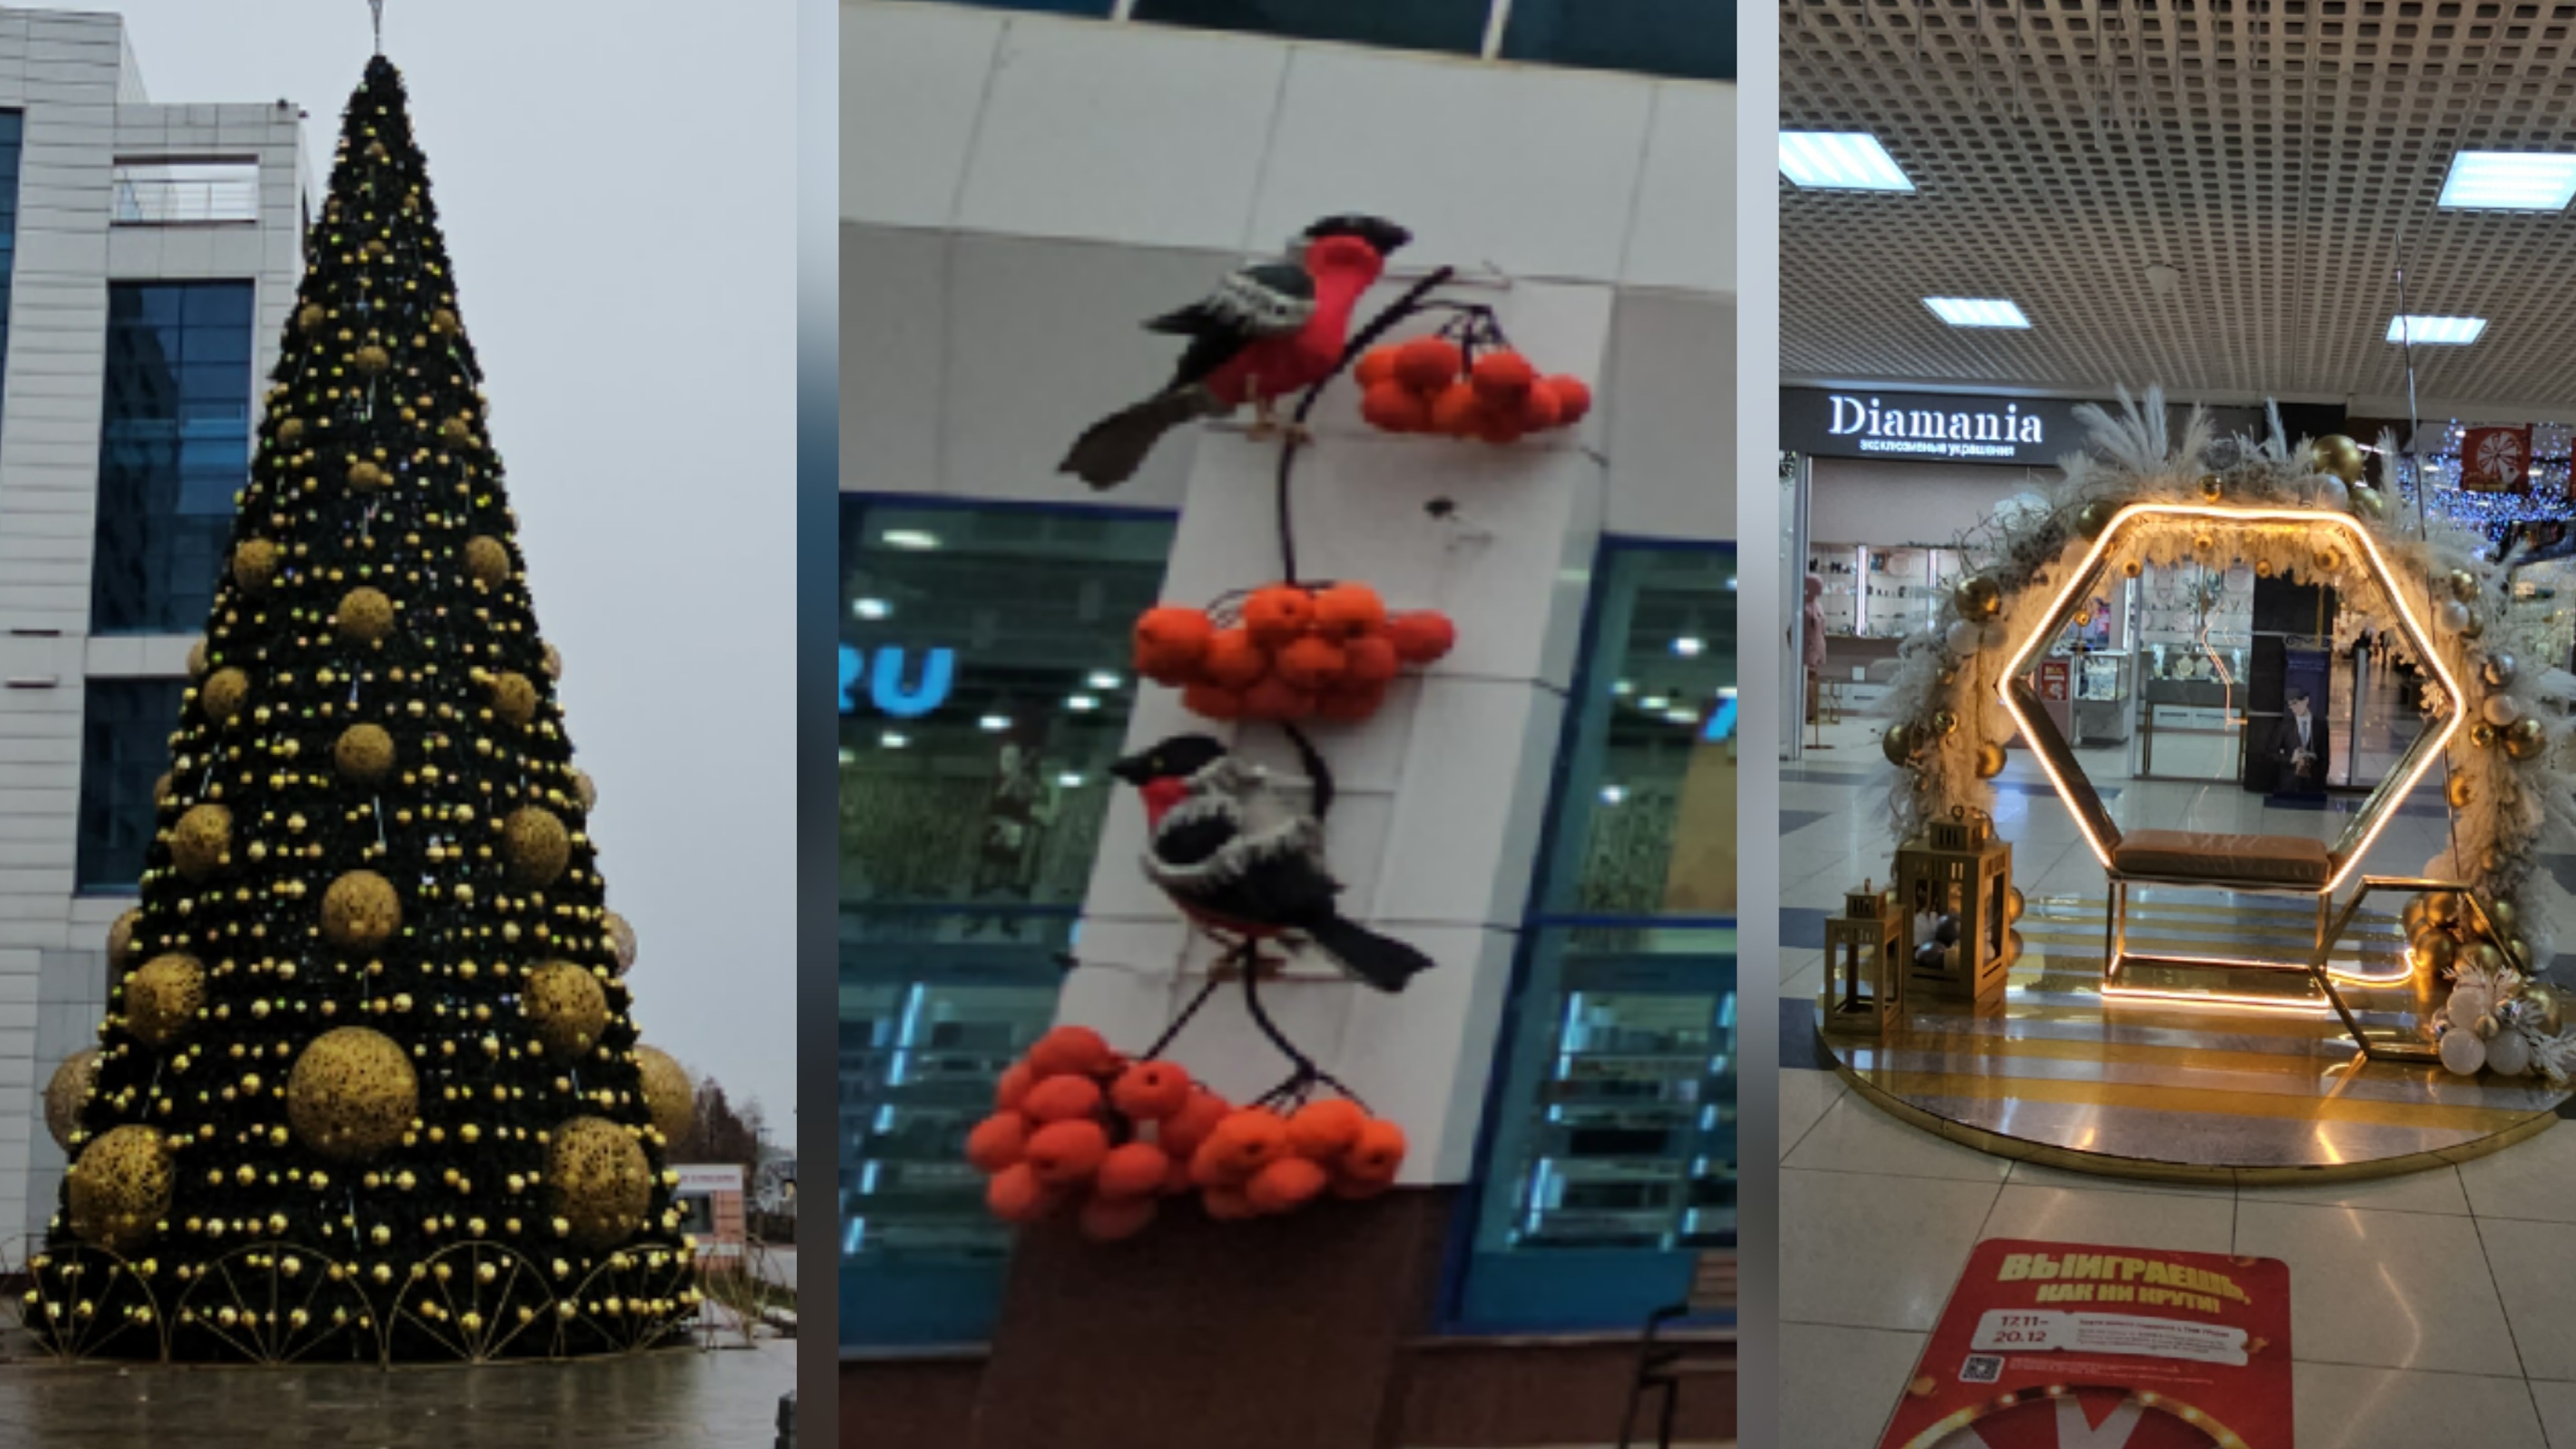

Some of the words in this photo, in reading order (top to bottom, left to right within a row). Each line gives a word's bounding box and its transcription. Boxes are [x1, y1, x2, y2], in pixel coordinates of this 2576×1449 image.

[1828, 396, 2042, 442] Diamania
[1948, 443, 2015, 457] украшения
[1998, 1253, 2251, 1305] ВЫИГРАЕШЬ,
[2036, 1284, 2094, 1302] КАК
[2097, 1284, 2133, 1302] НИ
[2137, 1287, 2220, 1313] КРУТИ!
[1993, 1330, 2047, 1342] 20.12
